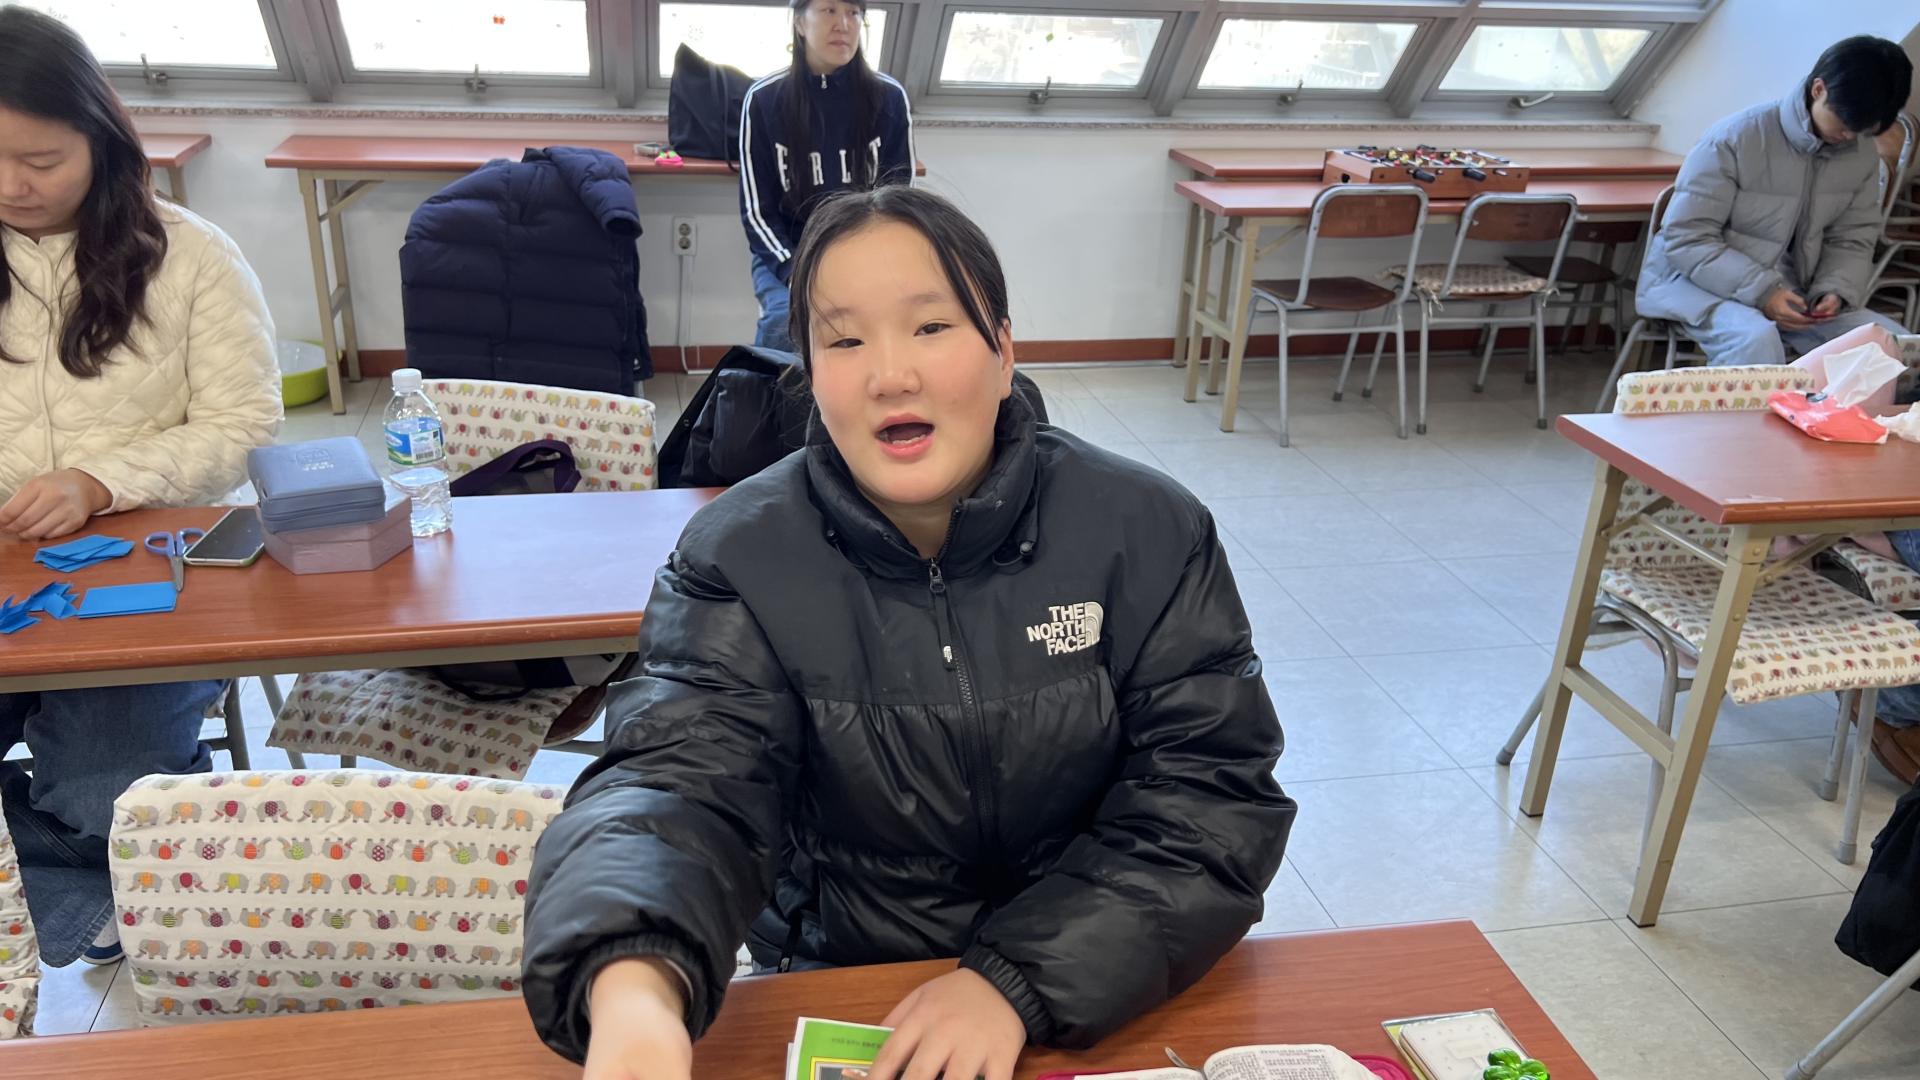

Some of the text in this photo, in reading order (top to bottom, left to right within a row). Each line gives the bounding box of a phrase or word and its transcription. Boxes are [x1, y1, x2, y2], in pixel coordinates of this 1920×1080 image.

[1048, 602, 1085, 622] THE
[1026, 618, 1086, 642] NORTH
[1046, 633, 1086, 656] FACE
